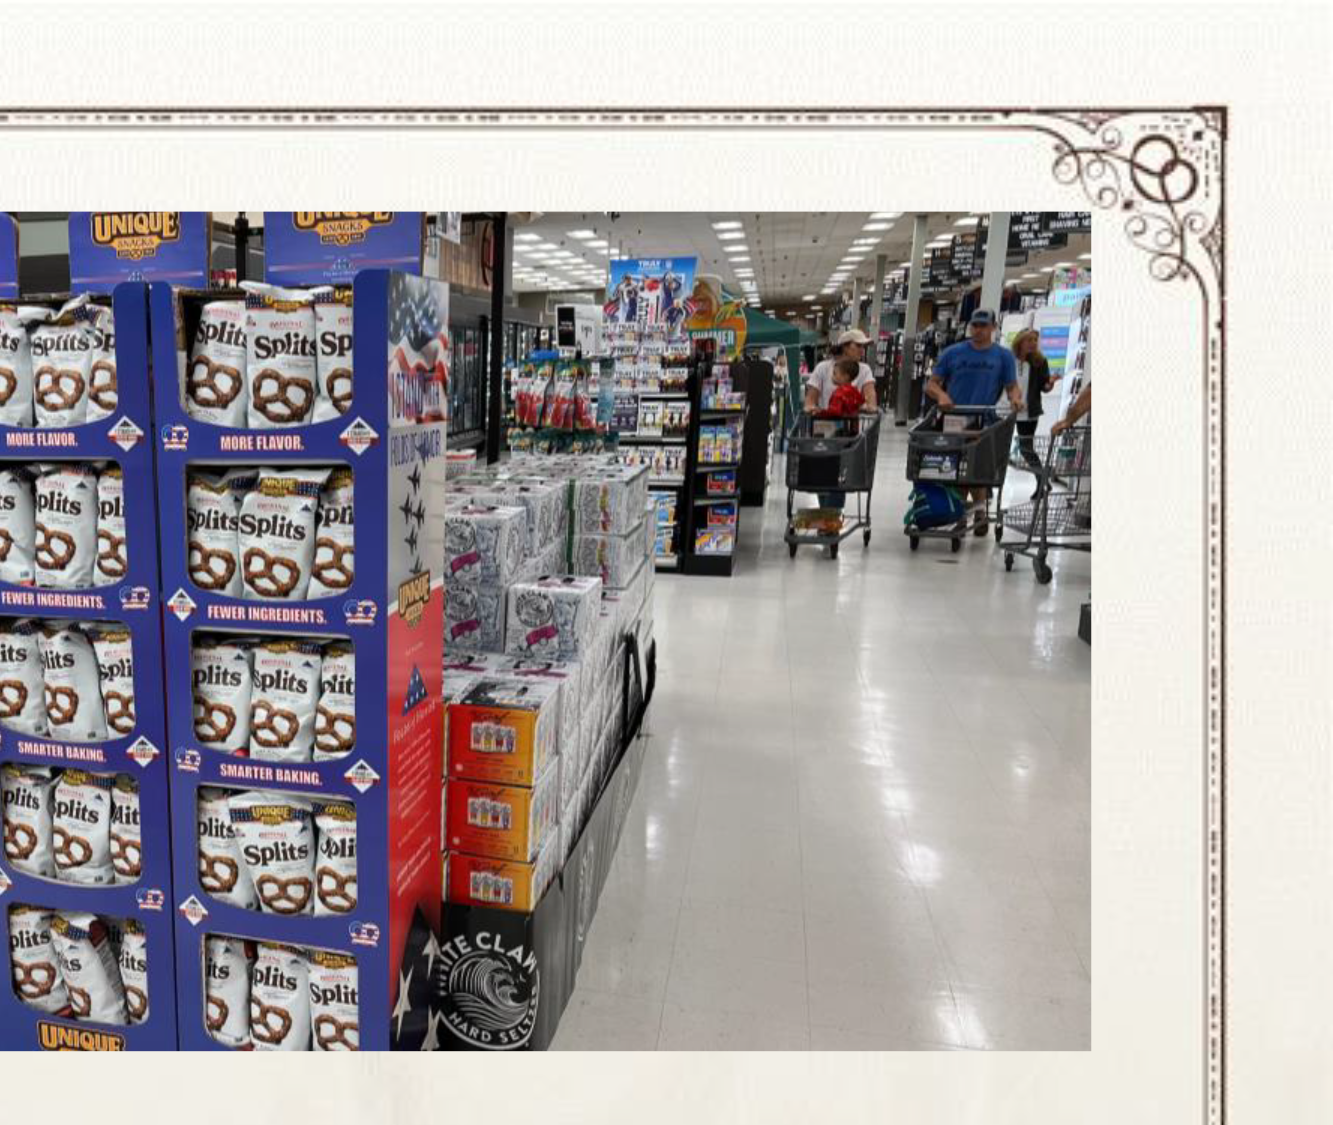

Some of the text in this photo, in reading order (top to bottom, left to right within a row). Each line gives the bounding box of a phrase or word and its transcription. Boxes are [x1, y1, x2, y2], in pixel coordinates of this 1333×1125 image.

[94, 212, 177, 243] UNIQUE
[323, 221, 364, 233] SNACKS
[118, 237, 154, 248] SNACKS
[31, 328, 90, 357] Splits
[253, 331, 317, 360] Splits
[6, 431, 78, 447] MORE FLAVOR.
[220, 435, 305, 451] MORE FLAVOR.
[238, 512, 307, 541] Splits
[2, 591, 106, 609] FEWER INGREDIENTS.
[207, 606, 327, 625] FEWER INGREDIENTS.
[18, 740, 107, 761] SMARTER BAKING.
[220, 763, 323, 786] SMARTER BAKING.
[244, 842, 310, 866] Splits
[309, 984, 358, 1005] Split
[39, 1022, 125, 1051] UNIQUE
[448, 1011, 493, 1043] HARD
